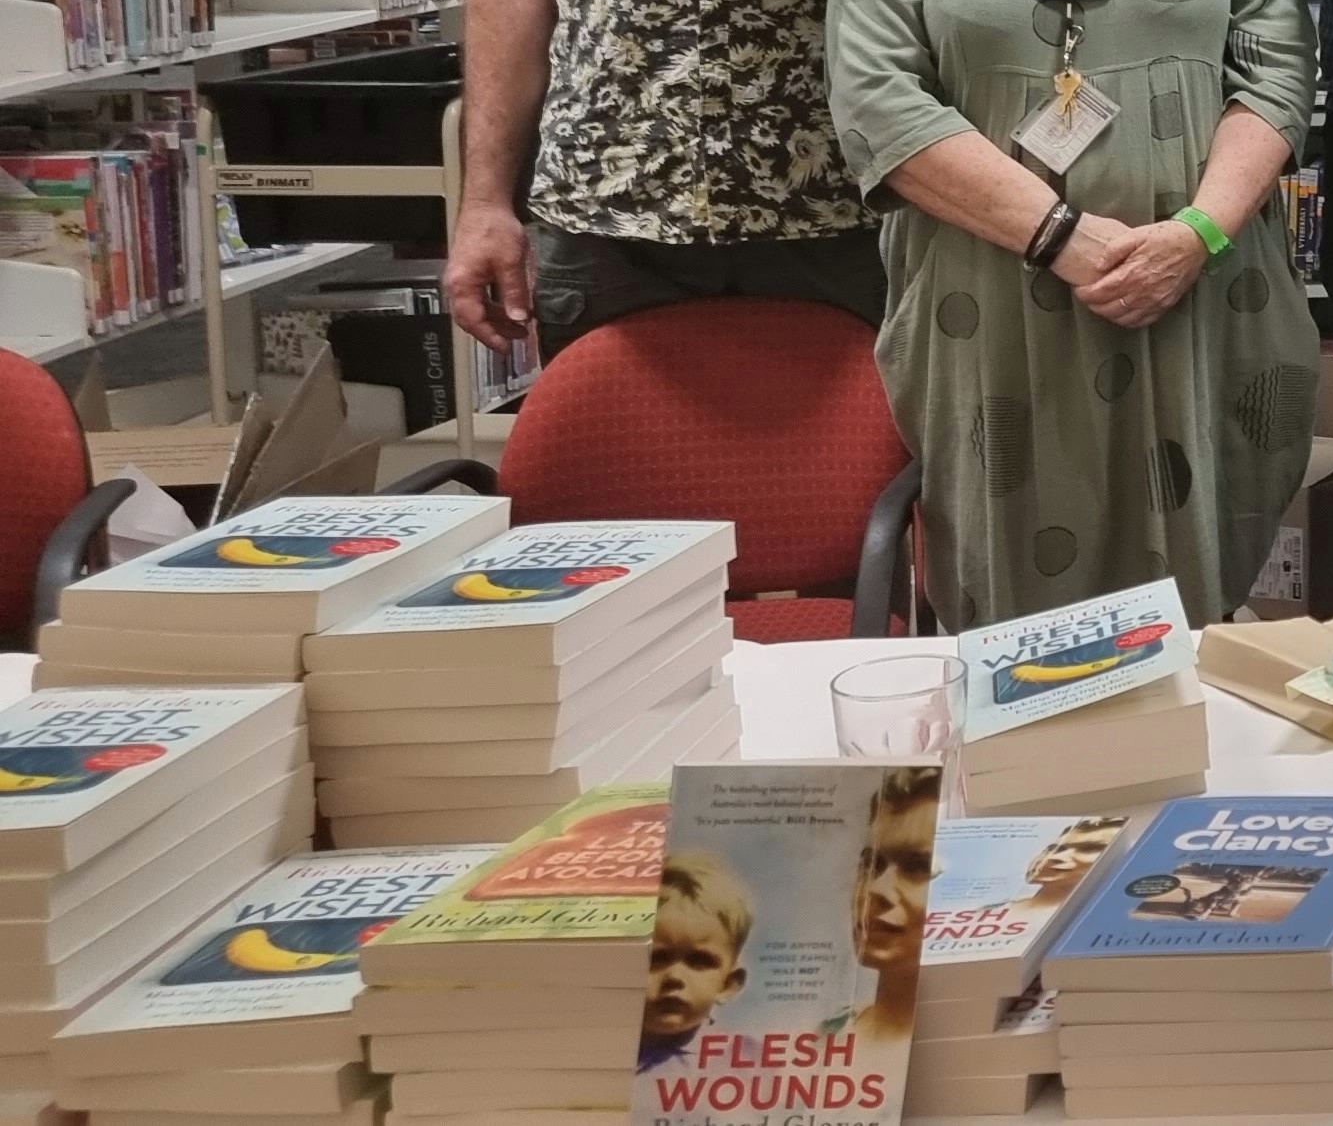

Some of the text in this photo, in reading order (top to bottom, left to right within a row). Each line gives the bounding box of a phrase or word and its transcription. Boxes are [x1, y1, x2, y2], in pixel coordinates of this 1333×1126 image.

[423, 332, 444, 380] Crafts
[284, 512, 417, 525] BEST
[227, 524, 427, 538] WISHES
[519, 540, 646, 555] BEST
[462, 552, 656, 570] WISHES
[982, 592, 1154, 645] Richard Glover
[1018, 607, 1127, 648] BEST
[981, 610, 1164, 670] WISHES
[37, 708, 193, 728] BEST
[628, 820, 667, 835] TH
[586, 836, 665, 850] LA
[544, 849, 663, 866] BEFOR
[287, 859, 472, 880] Richard Glov
[499, 865, 662, 881] AVOCAD
[300, 874, 456, 898] BEST
[235, 894, 437, 924] WISHE
[409, 907, 655, 930] Richard Glover
[925, 908, 1010, 925] ESH
[928, 938, 1014, 952] Glover
[1090, 928, 1305, 948] Richard Glover
[798, 966, 820, 975] NOT
[698, 1034, 856, 1070] FLESH
[656, 1074, 885, 1113] WOUNDS
